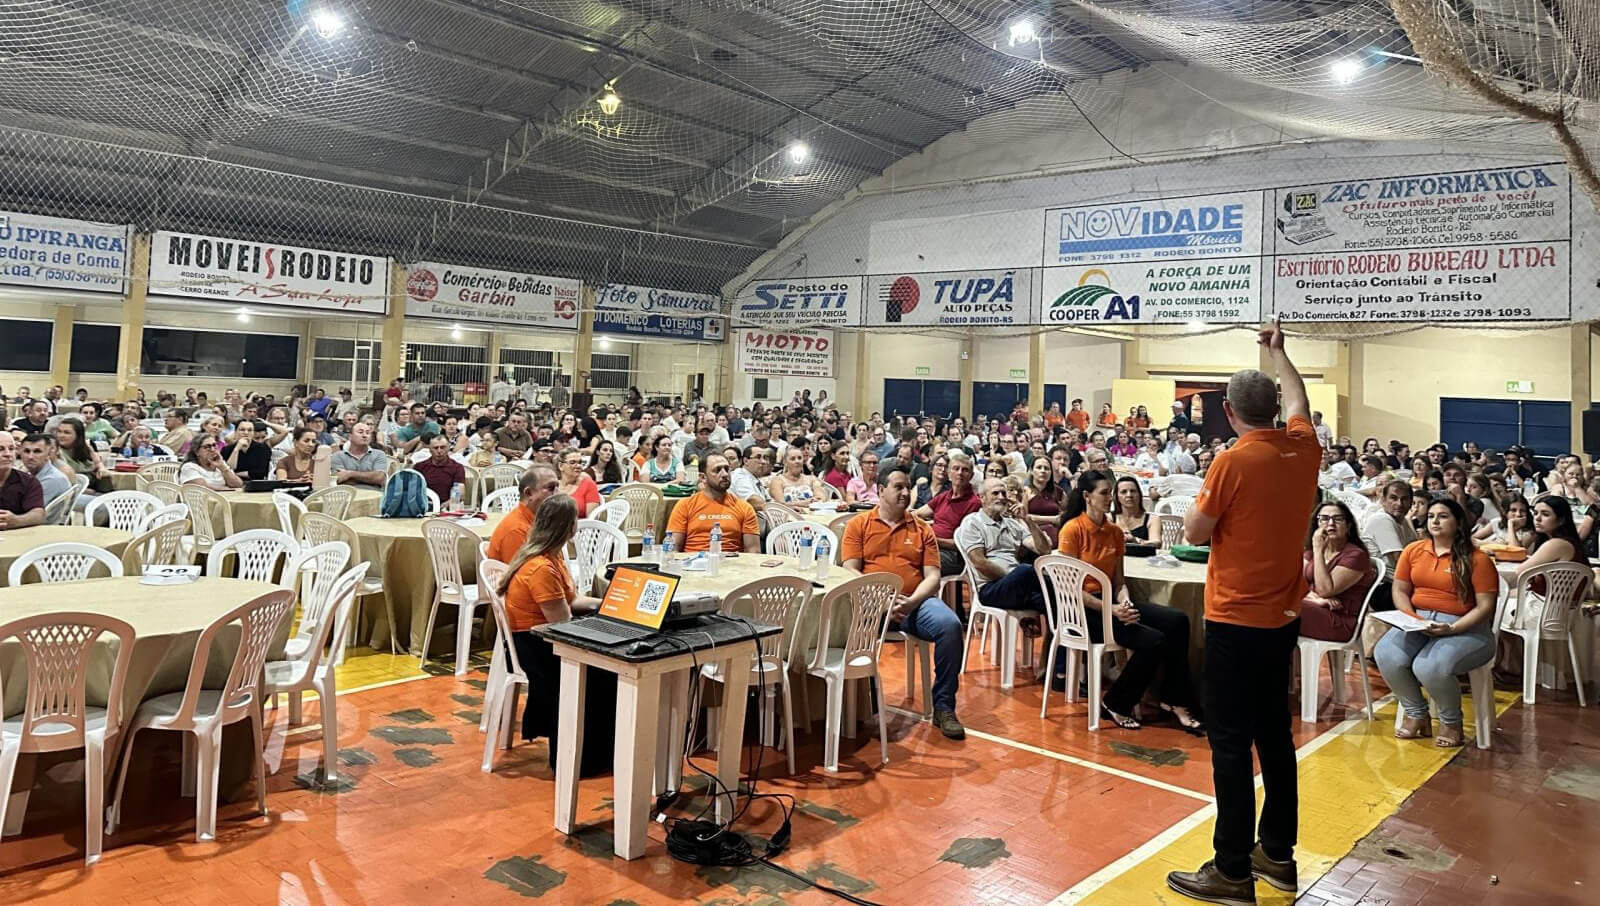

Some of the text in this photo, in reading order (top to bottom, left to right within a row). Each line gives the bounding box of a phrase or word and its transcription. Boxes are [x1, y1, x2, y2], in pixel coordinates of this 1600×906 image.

[1322, 168, 1558, 203] ZAC INFORMÁTICA
[1295, 194, 1317, 209] ZAC
[1471, 193, 1486, 202] de
[1386, 225, 1419, 235] Rodeio
[16, 226, 124, 253] IPIRANGA
[52, 251, 72, 265] de
[1059, 255, 1084, 263] FONE
[1153, 249, 1196, 257] RODEIO
[1198, 246, 1242, 255] BONITO
[1347, 254, 1401, 275] RODEIO
[1407, 250, 1489, 272] BUREAU
[1497, 246, 1556, 269] LTDA
[280, 249, 374, 286] RODEIO
[1146, 264, 1251, 279] A FORÇA DE UM
[443, 270, 501, 291] Comércio
[508, 275, 553, 297] Bebidas
[788, 283, 849, 293] Posto do
[934, 270, 1017, 305] TUPÃ
[1148, 281, 1186, 292] NOVO
[1295, 278, 1368, 290] Orientação
[1433, 276, 1443, 285] e
[1448, 272, 1497, 285] Fiscal
[457, 287, 516, 307] Garbin
[741, 284, 848, 311] SETTI
[1160, 298, 1173, 306] DO
[1228, 296, 1250, 305] 1124
[1355, 294, 1393, 308] junto
[1396, 295, 1414, 303] ao
[822, 310, 847, 318] PRECISA
[942, 303, 1013, 314] AUTO PEÇAS
[1050, 295, 1140, 321] COOPER A1
[1195, 310, 1216, 318] 3798
[1219, 309, 1240, 317] 1592
[1292, 311, 1304, 320] Do
[604, 311, 649, 326] DOMENICO
[660, 317, 703, 331] LOTERIAS
[939, 316, 968, 324] RODEIO
[745, 332, 829, 352] MIOTTO
